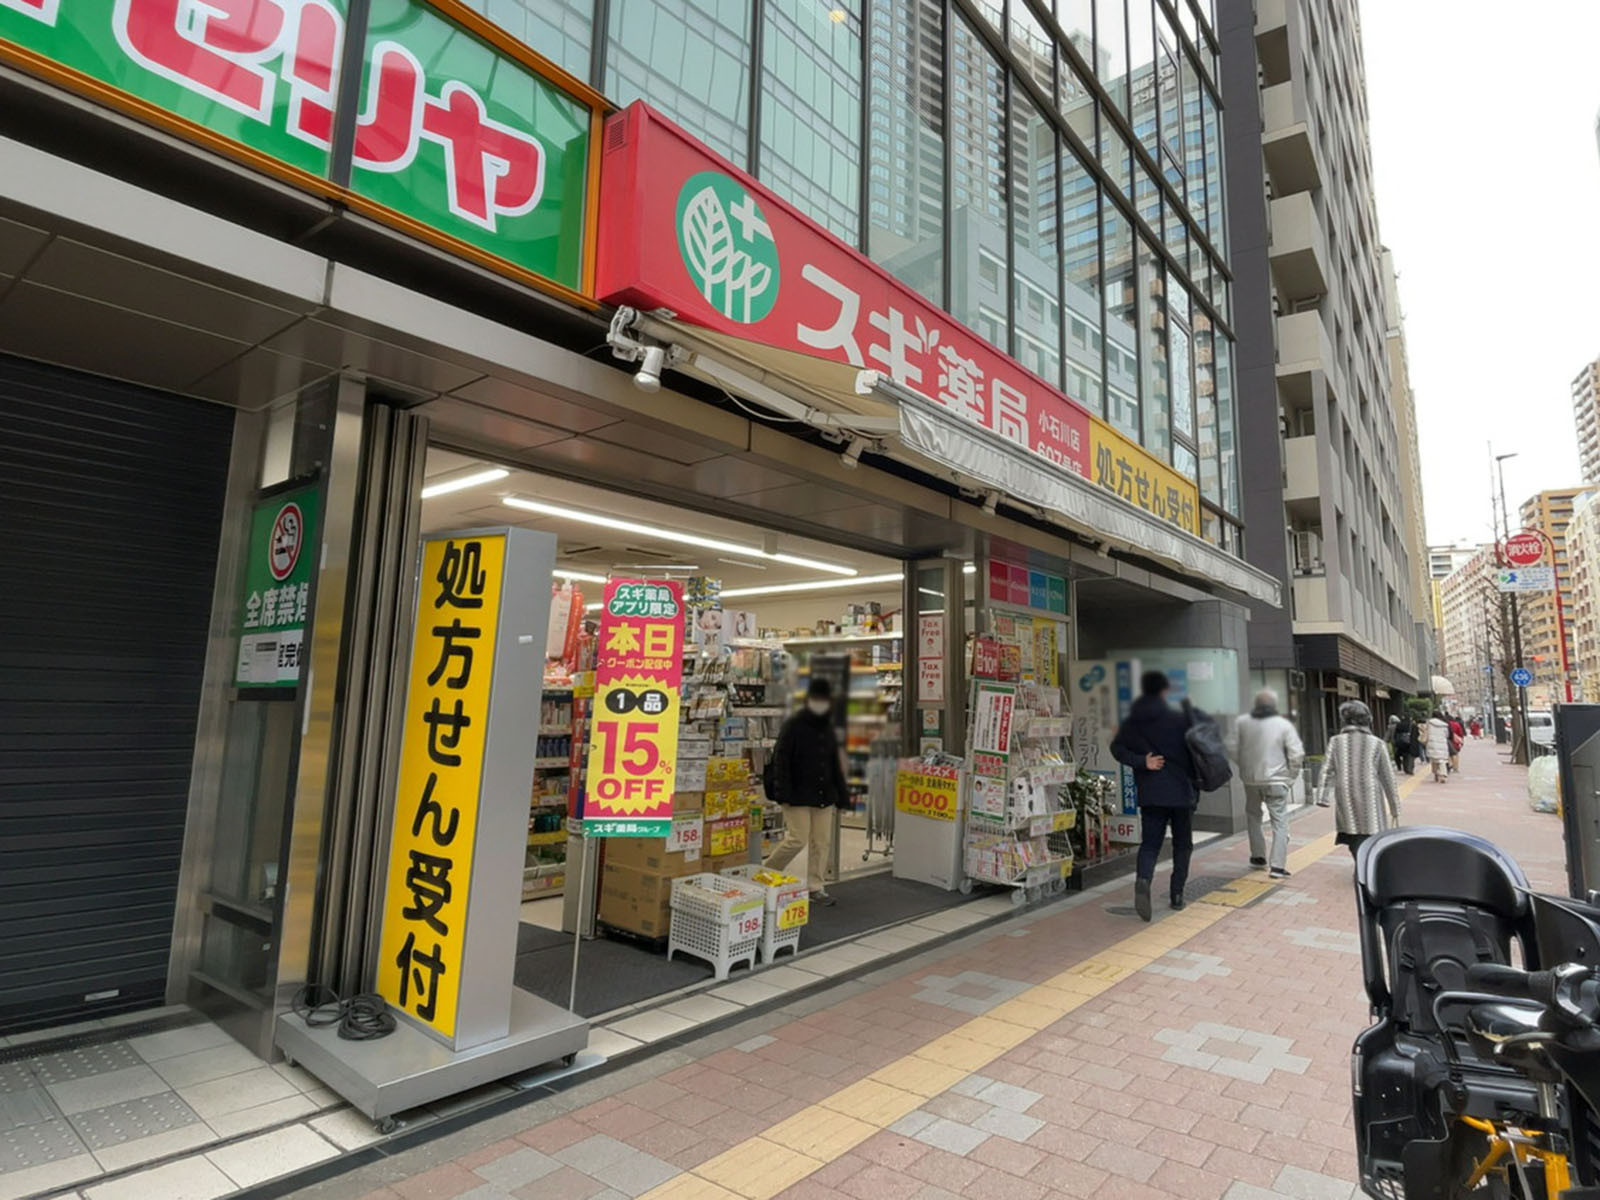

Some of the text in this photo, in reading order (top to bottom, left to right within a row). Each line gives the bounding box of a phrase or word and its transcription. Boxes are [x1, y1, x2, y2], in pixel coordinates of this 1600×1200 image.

[0, 0, 545, 232] ゼリヤ
[797, 263, 1029, 450] スギ薬局
[1038, 410, 1080, 453] 小石川店
[1096, 441, 1194, 534] 処方せん受付
[1508, 542, 1541, 556] 消火栓
[618, 587, 670, 602] スギ薬局
[612, 600, 677, 616] アプリ限定
[922, 619, 939, 628] Tax
[605, 622, 675, 659] 本日
[921, 628, 941, 638] Free
[607, 658, 673, 670] クーポン配信中
[922, 661, 939, 670] Tax
[921, 670, 941, 680] Free
[1078, 716, 1089, 766] クリニック
[396, 540, 487, 1022] 処方せん受付
[596, 778, 665, 800] OFF
[898, 787, 948, 811] 1000
[675, 829, 698, 844] 158
[1117, 824, 1135, 837] 6F
[784, 907, 805, 922] 178
[738, 919, 759, 935] 198
